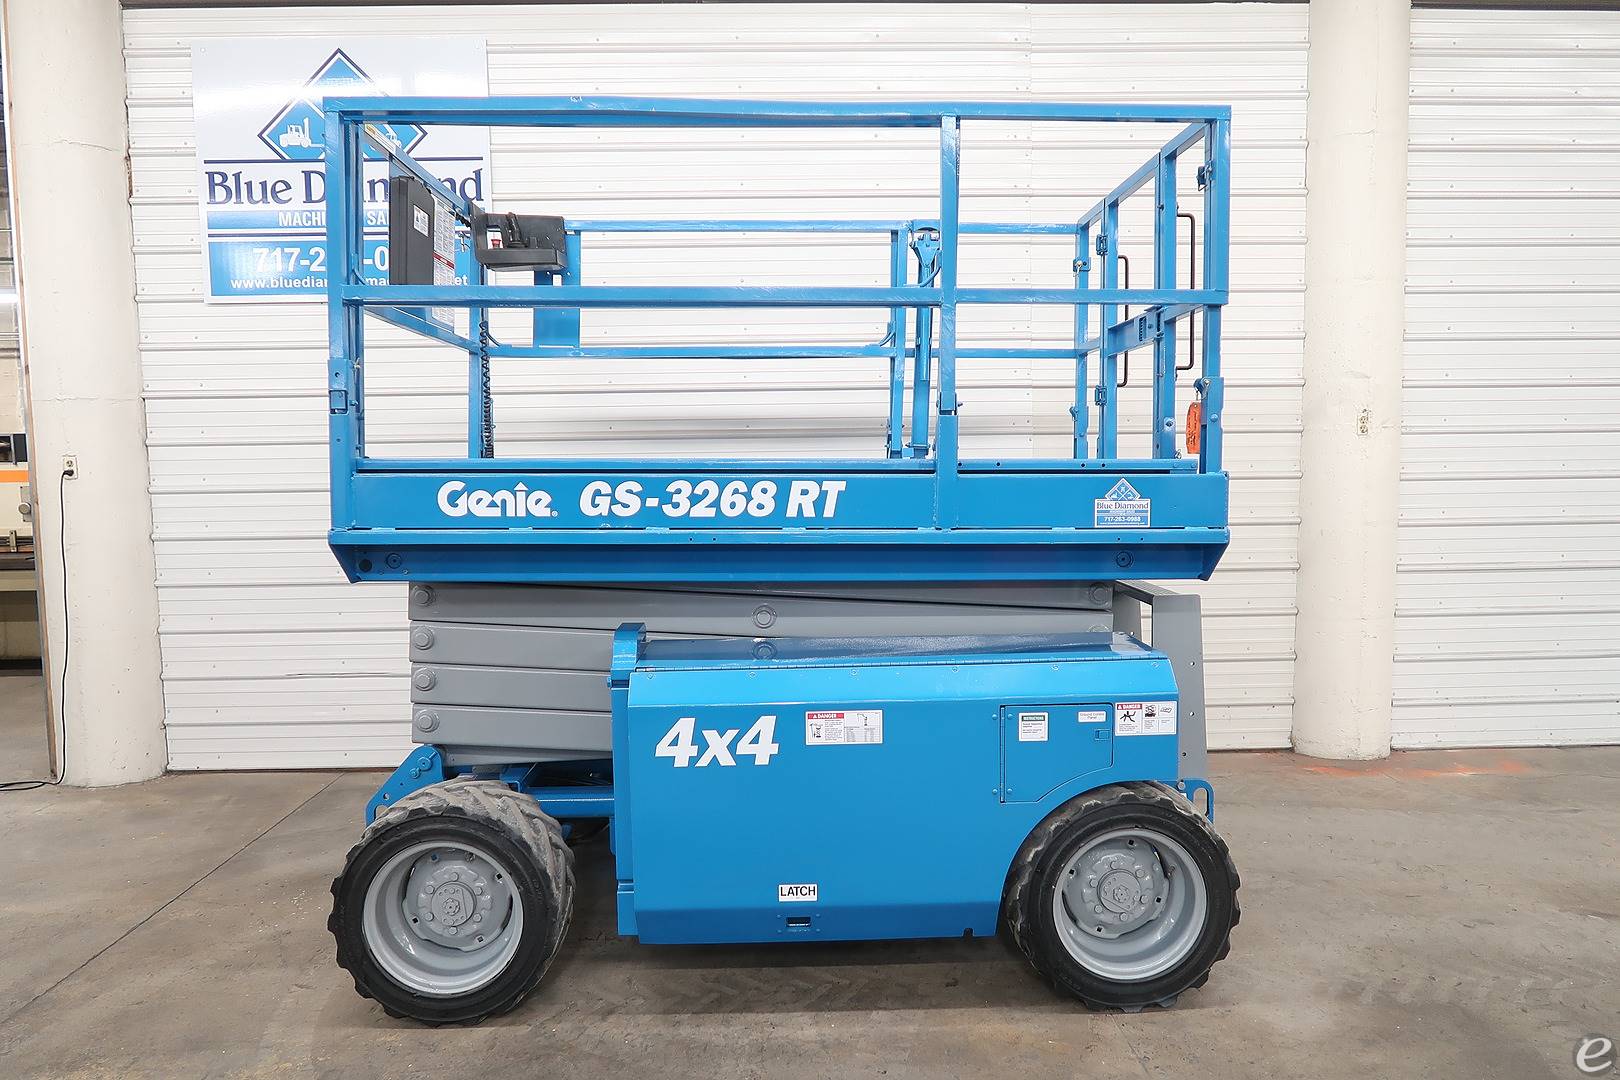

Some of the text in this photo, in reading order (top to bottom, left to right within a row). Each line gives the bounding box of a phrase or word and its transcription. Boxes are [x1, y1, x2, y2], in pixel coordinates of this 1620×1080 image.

[205, 170, 293, 205] Blue
[437, 480, 847, 518] Genie GS-3268 RT
[655, 715, 779, 768] 4x4
[780, 886, 816, 896] LATCH
